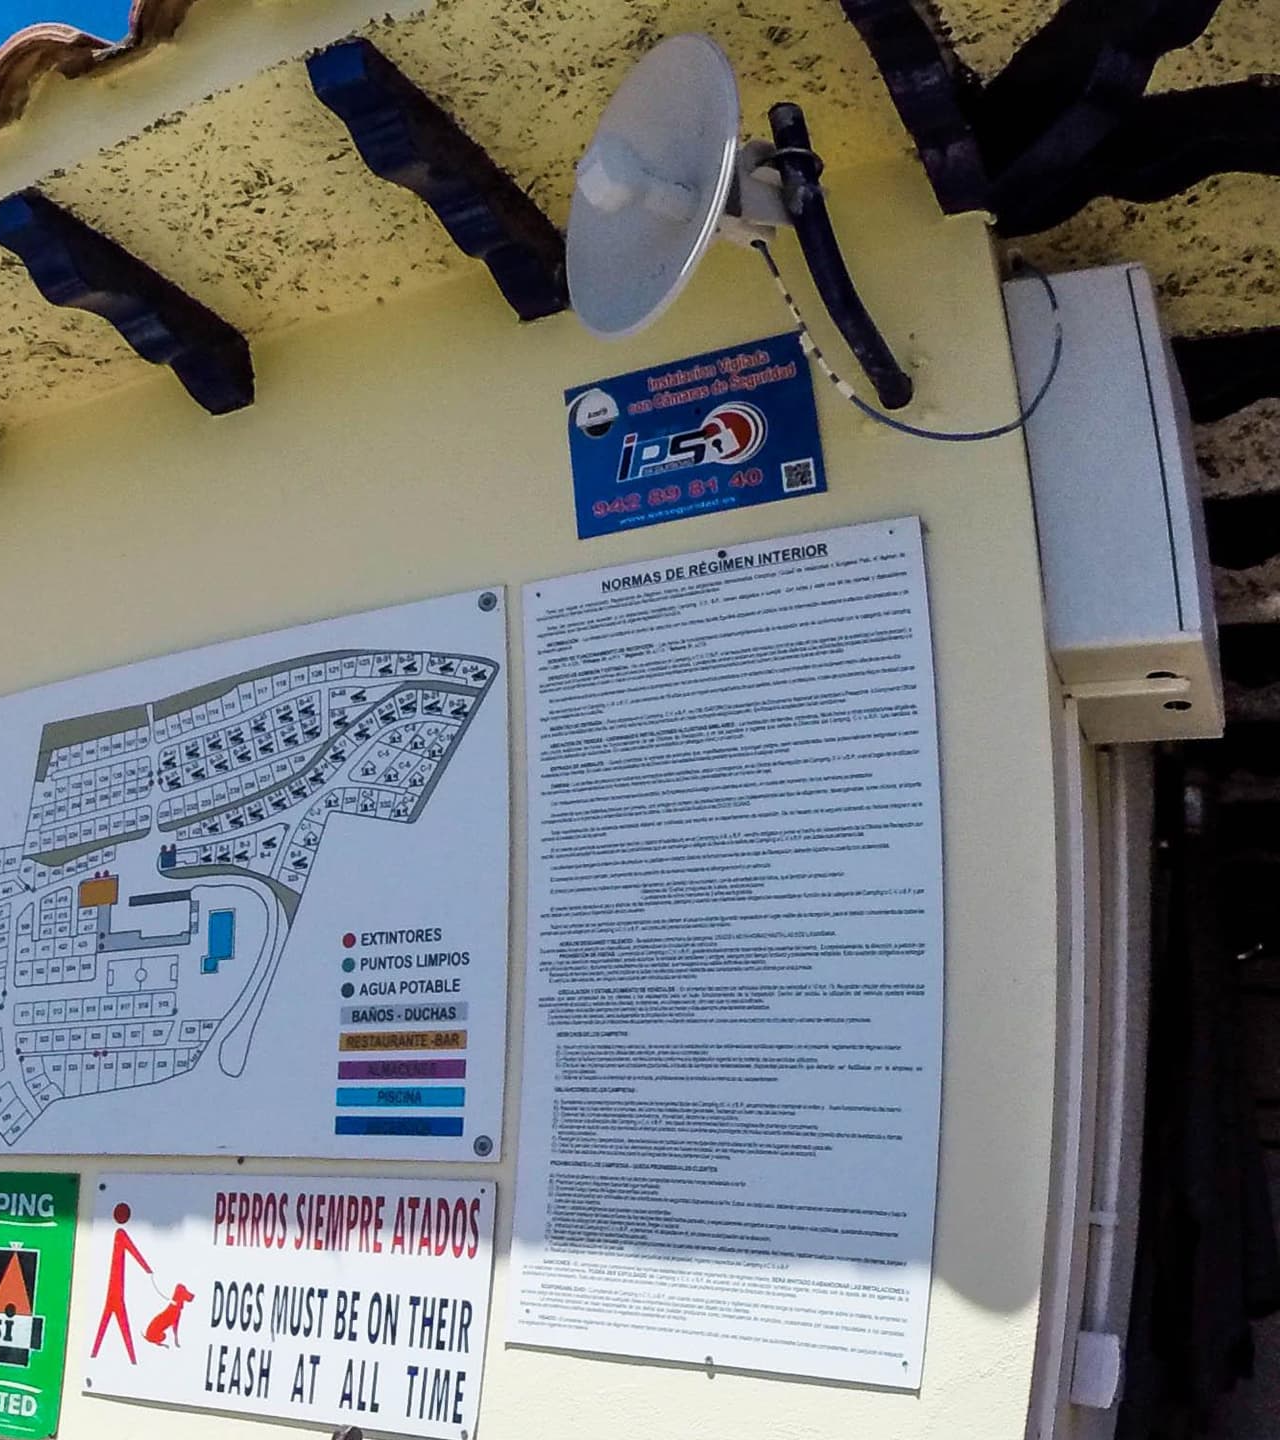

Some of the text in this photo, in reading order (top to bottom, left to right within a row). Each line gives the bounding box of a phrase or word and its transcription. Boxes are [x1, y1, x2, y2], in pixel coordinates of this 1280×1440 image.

[592, 467, 764, 518] 942 89 81 40
[601, 543, 827, 592] NORMAS DE RÉGIMEN INTERIOR
[361, 928, 442, 946] EXTINTORES
[360, 952, 470, 971] PUNTOS LIMPIOS
[359, 979, 461, 996] AGUA POTABLE
[352, 1006, 394, 1023] BAÑOS
[405, 1006, 456, 1021] DUCHAS
[346, 1033, 428, 1048] RESTAURANTE
[378, 1090, 422, 1104] PISCINA
[214, 1192, 481, 1259] PERROS SIEMPRE ATADOS
[210, 1281, 473, 1353] DOGS MUST BE ON THEIR
[204, 1345, 466, 1424] LEASH AT ALL TIME
